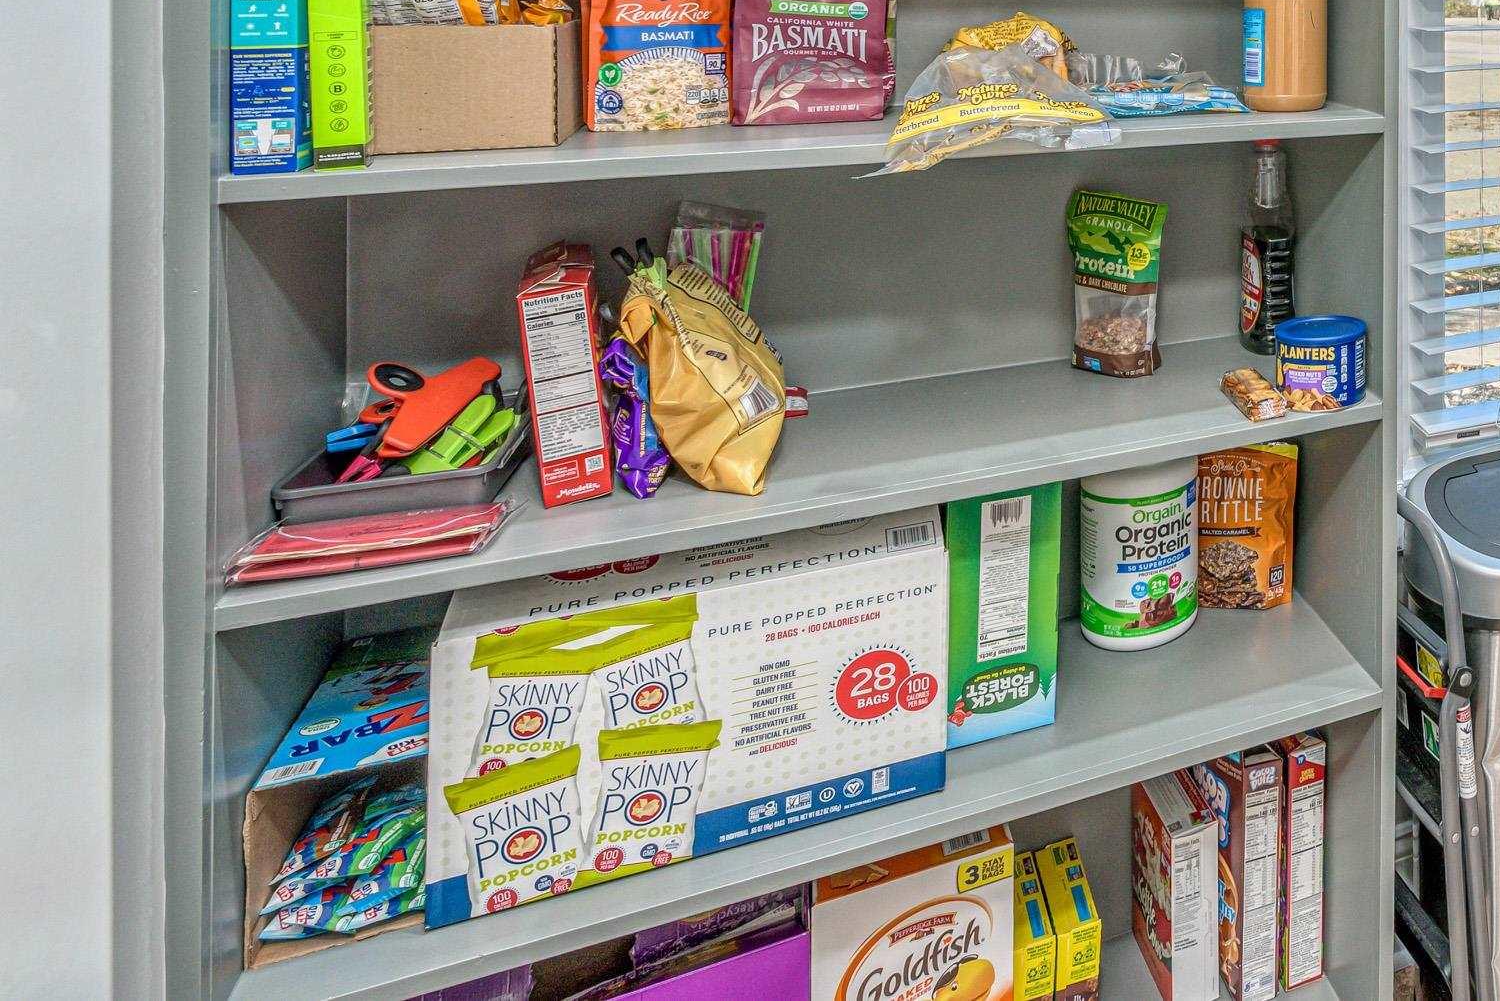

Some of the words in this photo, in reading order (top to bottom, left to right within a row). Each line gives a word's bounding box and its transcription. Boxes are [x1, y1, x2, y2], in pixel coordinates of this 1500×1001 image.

[615, 3, 679, 27] Ready
[679, 2, 712, 21] Rice
[778, 2, 845, 15] ORGANIC
[767, 17, 822, 27] CALIFORNIA
[826, 20, 855, 28] WHITE
[640, 31, 695, 42] BASMATI
[752, 23, 868, 64] BASMATI
[958, 83, 1019, 100] Nature's
[970, 92, 1006, 105] Own
[959, 103, 1021, 118] Butterbread
[1079, 196, 1117, 214] NATURE
[1117, 200, 1155, 228] VALLEY
[1085, 216, 1134, 233] GRANOLA
[1088, 278, 1102, 287] DARK
[1101, 280, 1128, 293] CHOCOLATE
[524, 295, 559, 308] Nutrition
[561, 291, 583, 301] Facts
[526, 320, 554, 330] Calories
[574, 312, 586, 321] 80
[1279, 344, 1335, 361] PLANTERS
[1197, 478, 1264, 500] ROWNIE
[1200, 500, 1264, 523] RITTLE
[1115, 512, 1192, 544] Organic
[1223, 528, 1250, 536] CARAMEL
[696, 548, 736, 561] ARTIFICIAL
[735, 543, 770, 554] FLAVORS
[1122, 531, 1190, 561] Protein
[1138, 552, 1185, 571] SUPERFOODS
[529, 595, 598, 617] PURE
[614, 575, 715, 602] POPPED
[729, 545, 878, 581] PERFECTION
[708, 622, 754, 638] PURE
[761, 606, 827, 628] POPPED
[834, 584, 934, 612] PERFECTION
[765, 633, 774, 642] 28
[776, 628, 799, 641] BAGS
[807, 623, 820, 634] 100
[822, 616, 858, 632] CALORIES
[860, 611, 881, 623] EACH
[759, 663, 772, 673] NON
[774, 659, 790, 669] GMO
[752, 673, 778, 685] GLUTEN
[779, 670, 796, 680] FREE
[850, 662, 896, 697] 28
[907, 677, 930, 694] 100
[755, 686, 776, 696] DAIRY
[776, 682, 793, 692] FREE
[906, 690, 930, 703] CALORIES
[972, 683, 1030, 711] BLACK
[609, 671, 689, 726] POP
[752, 696, 778, 708] PEANUT
[779, 693, 796, 702] FREE
[857, 694, 890, 709] BAGS
[750, 711, 766, 721] TREE
[767, 708, 780, 717] NUT
[782, 704, 799, 713] FREE
[485, 706, 573, 742] POP
[741, 718, 789, 734] PRESERVATIVE
[789, 713, 807, 723] FREE
[746, 730, 781, 745] ARTIFICIAL
[783, 724, 812, 736] FLAVORS
[480, 741, 566, 756] POPCORN
[660, 746, 700, 754] PERFECTION
[759, 738, 798, 754] DELICIOUS!
[520, 774, 563, 792] PERFECTION
[600, 786, 693, 831] POP
[595, 823, 688, 845] POPCORN
[475, 814, 572, 879] POP
[602, 850, 619, 862] 100
[982, 855, 1005, 869] STAY
[480, 848, 578, 892] POPCORN
[964, 865, 980, 886] 3
[981, 868, 1005, 881] BAGS
[491, 892, 511, 902] 100
[893, 918, 934, 941] PEPPERIDGE
[933, 915, 952, 926] FARM
[858, 918, 982, 1001] Goldfish
